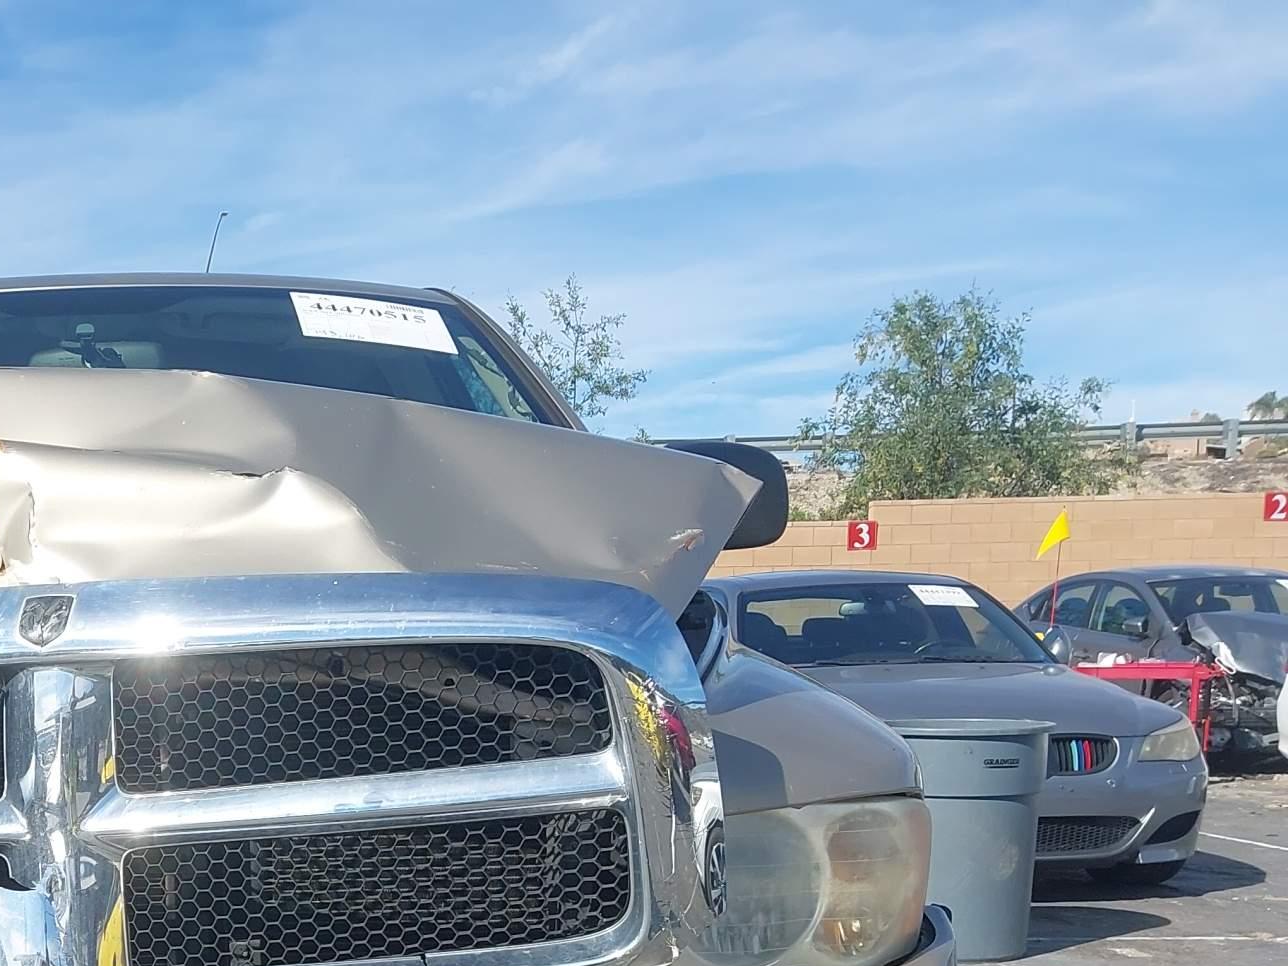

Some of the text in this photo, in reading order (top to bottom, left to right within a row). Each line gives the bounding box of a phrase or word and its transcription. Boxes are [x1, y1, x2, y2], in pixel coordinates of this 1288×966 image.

[309, 303, 427, 323] 44470515
[1269, 493, 1288, 519] 2
[853, 523, 870, 548] 3
